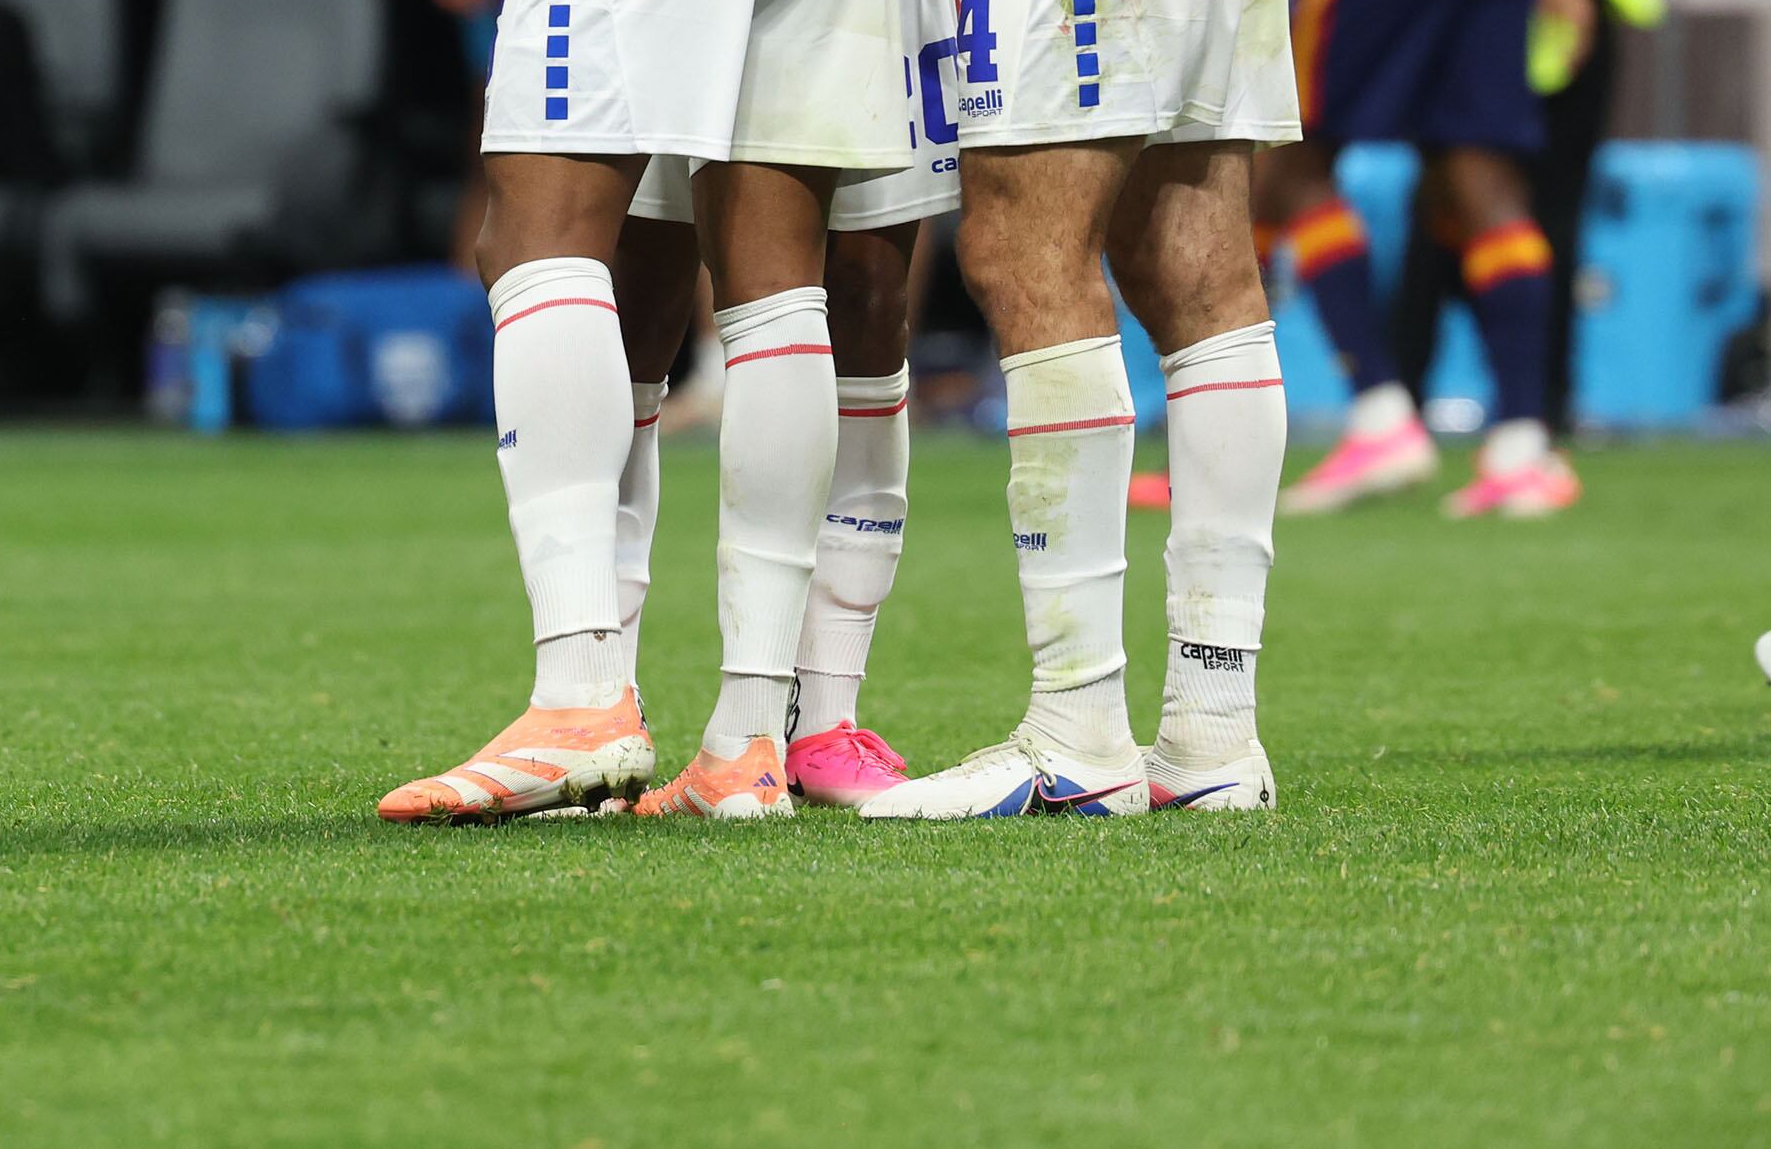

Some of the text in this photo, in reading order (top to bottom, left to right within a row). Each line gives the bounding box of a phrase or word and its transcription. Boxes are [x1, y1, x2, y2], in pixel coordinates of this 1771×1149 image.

[958, 89, 1003, 116] apelli
[972, 108, 1003, 118] SPORT
[826, 514, 904, 531] capelli
[1208, 660, 1244, 673] SPORT
